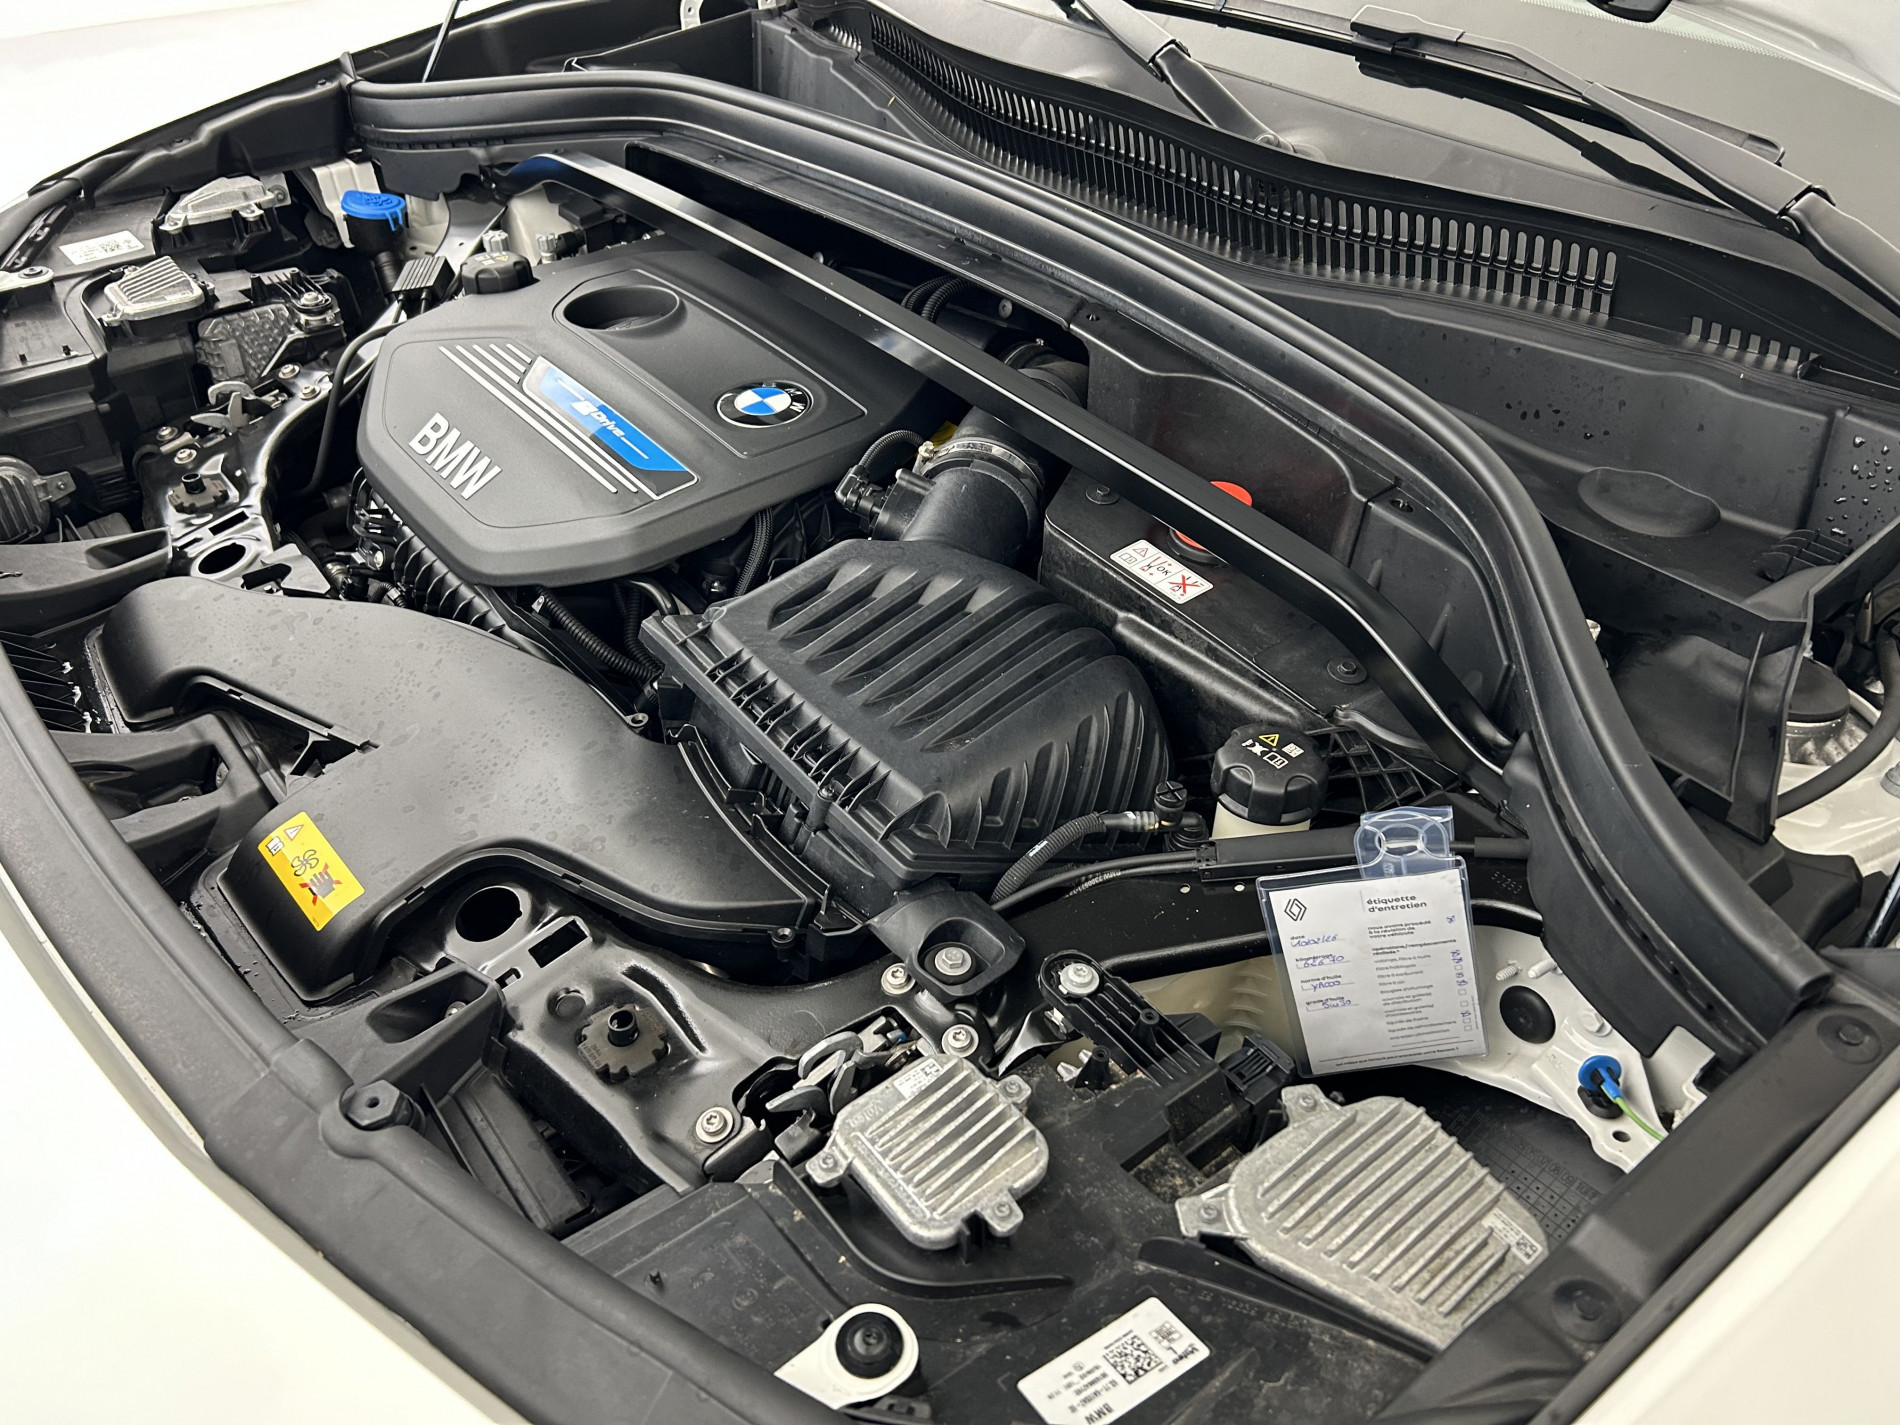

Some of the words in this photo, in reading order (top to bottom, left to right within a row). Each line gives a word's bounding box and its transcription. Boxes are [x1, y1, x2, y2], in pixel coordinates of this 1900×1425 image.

[408, 412, 502, 500] BMW
[1156, 566, 1172, 576] OK
[1366, 895, 1416, 905] étiquette
[1368, 902, 1427, 913] d'entretien
[1085, 1402, 1114, 1424] BMW
